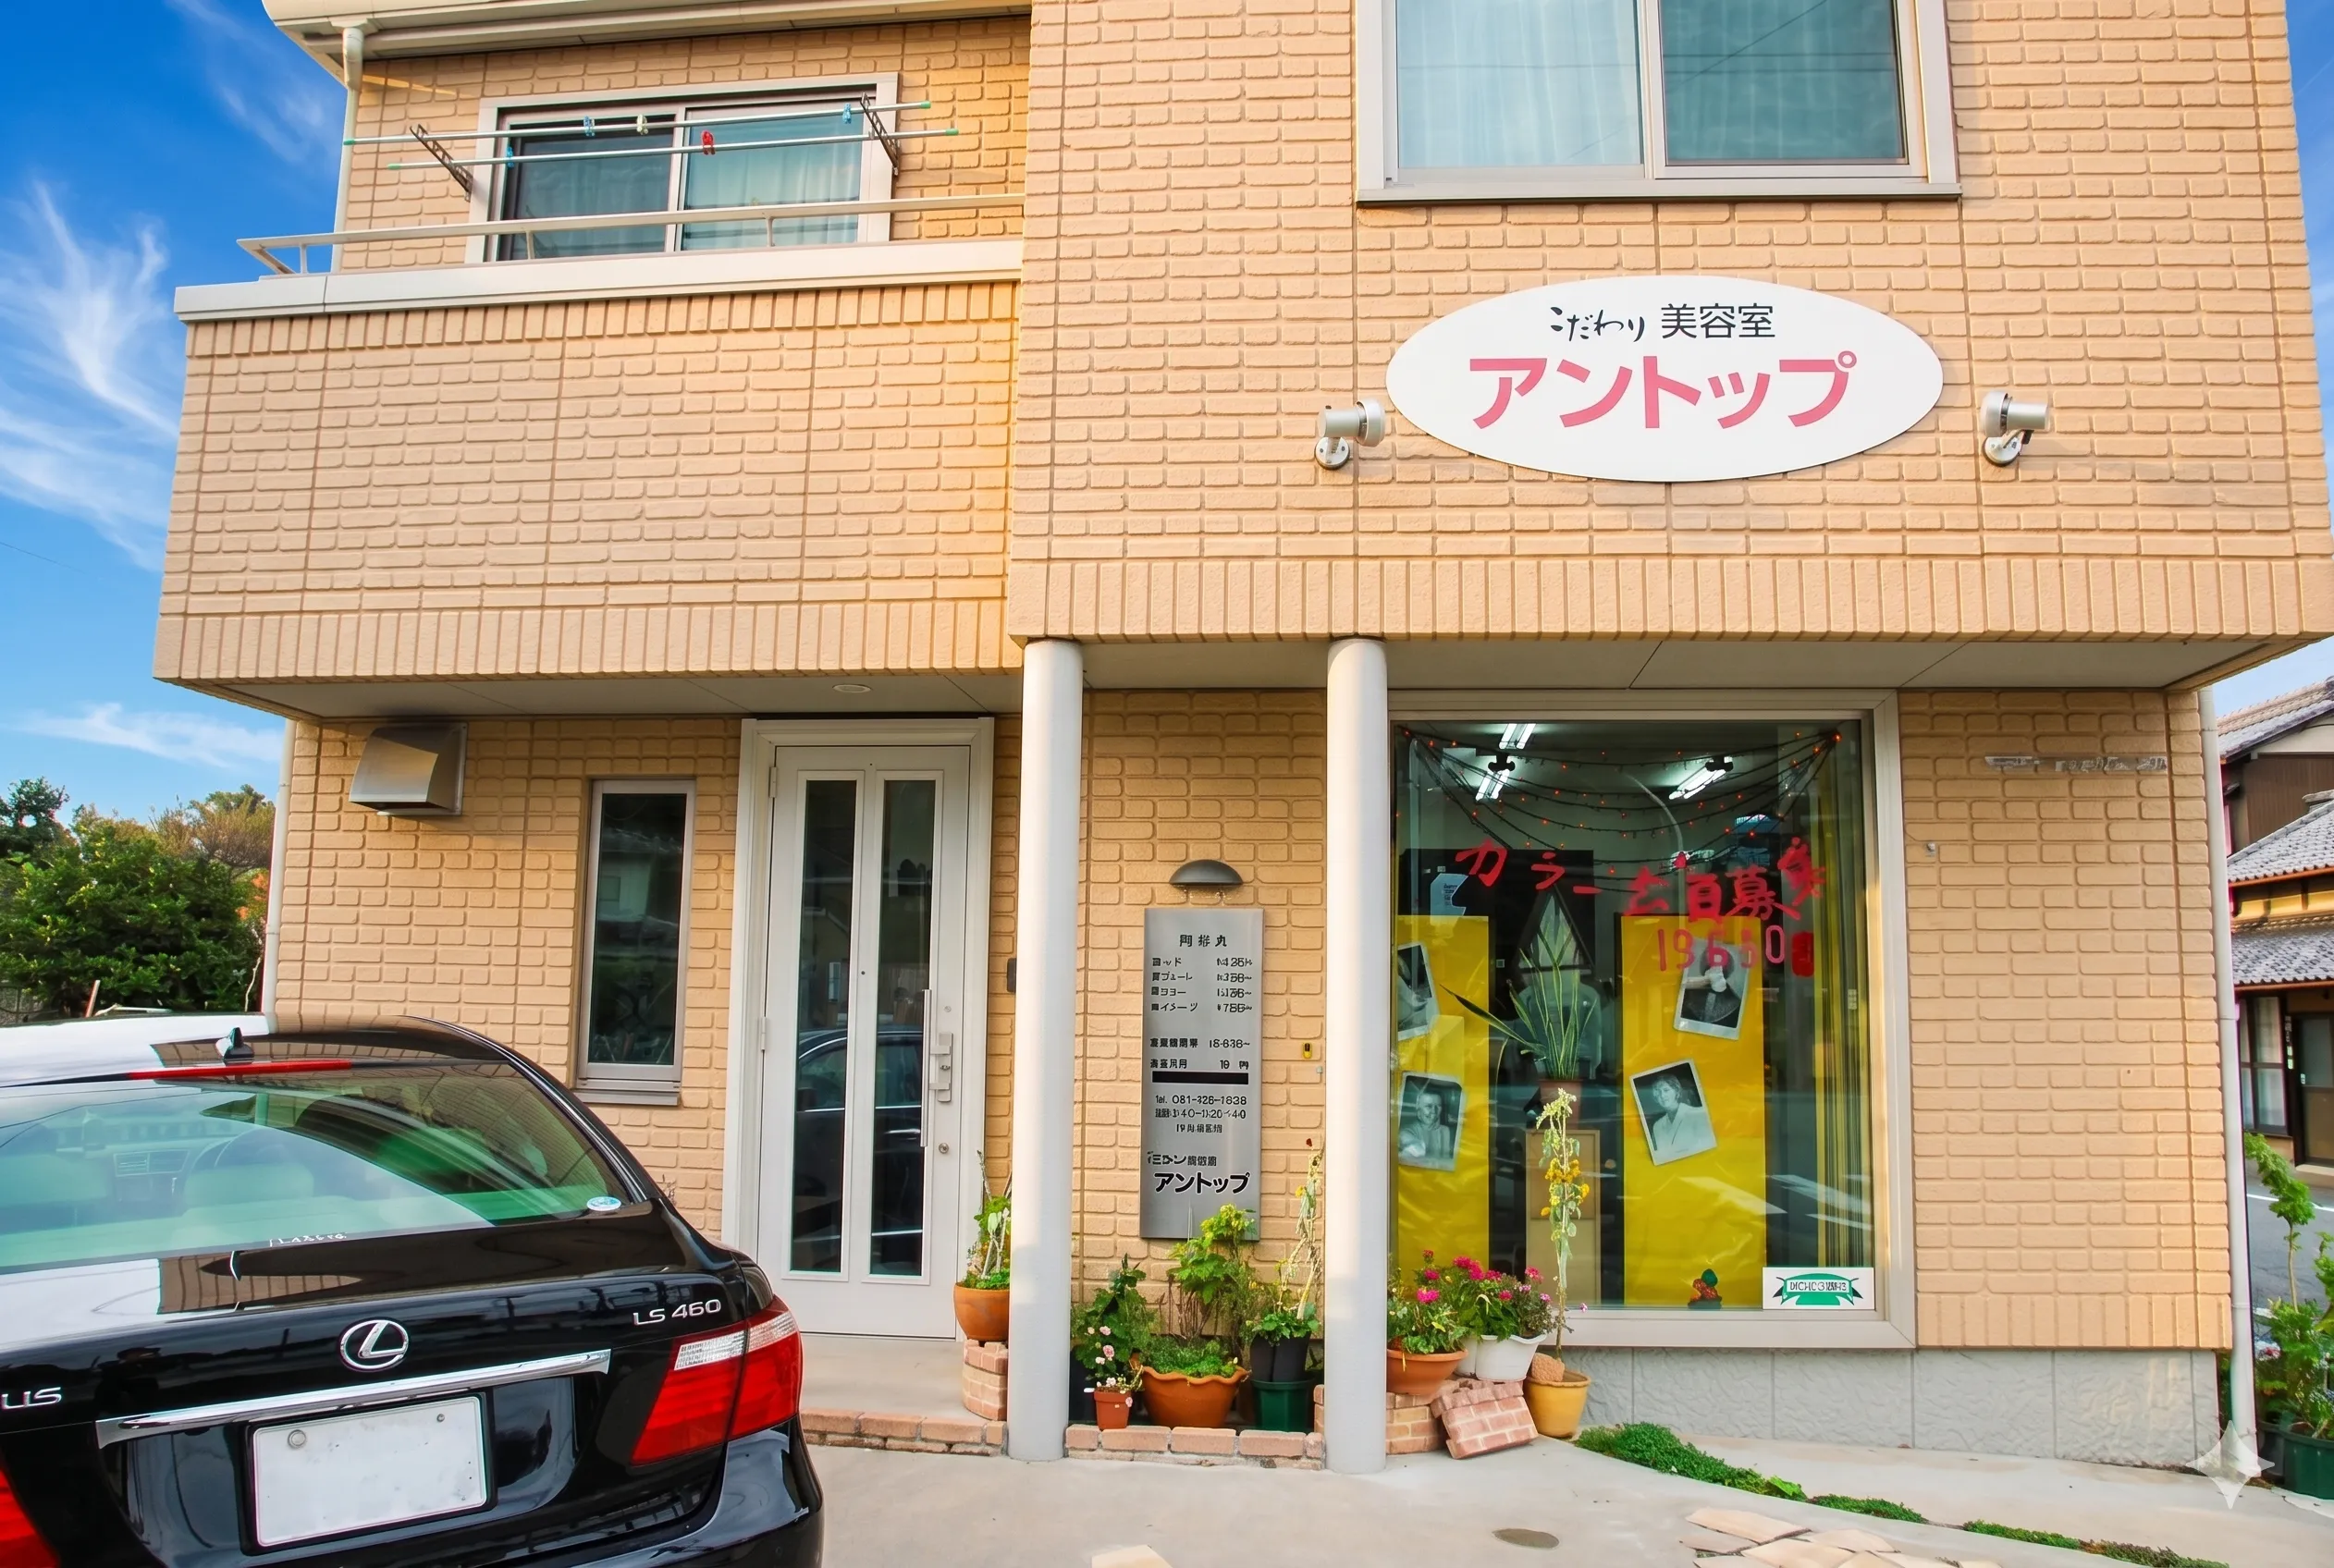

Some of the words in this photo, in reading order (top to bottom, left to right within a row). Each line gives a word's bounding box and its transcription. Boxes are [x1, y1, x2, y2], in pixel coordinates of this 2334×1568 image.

[1550, 306, 1645, 342] こだわり
[1661, 303, 1775, 339] 美容室
[1469, 350, 1857, 429] アントップ
[1154, 1171, 1250, 1194] アントップ
[633, 1308, 666, 1326] LS
[671, 1299, 721, 1318] 460
